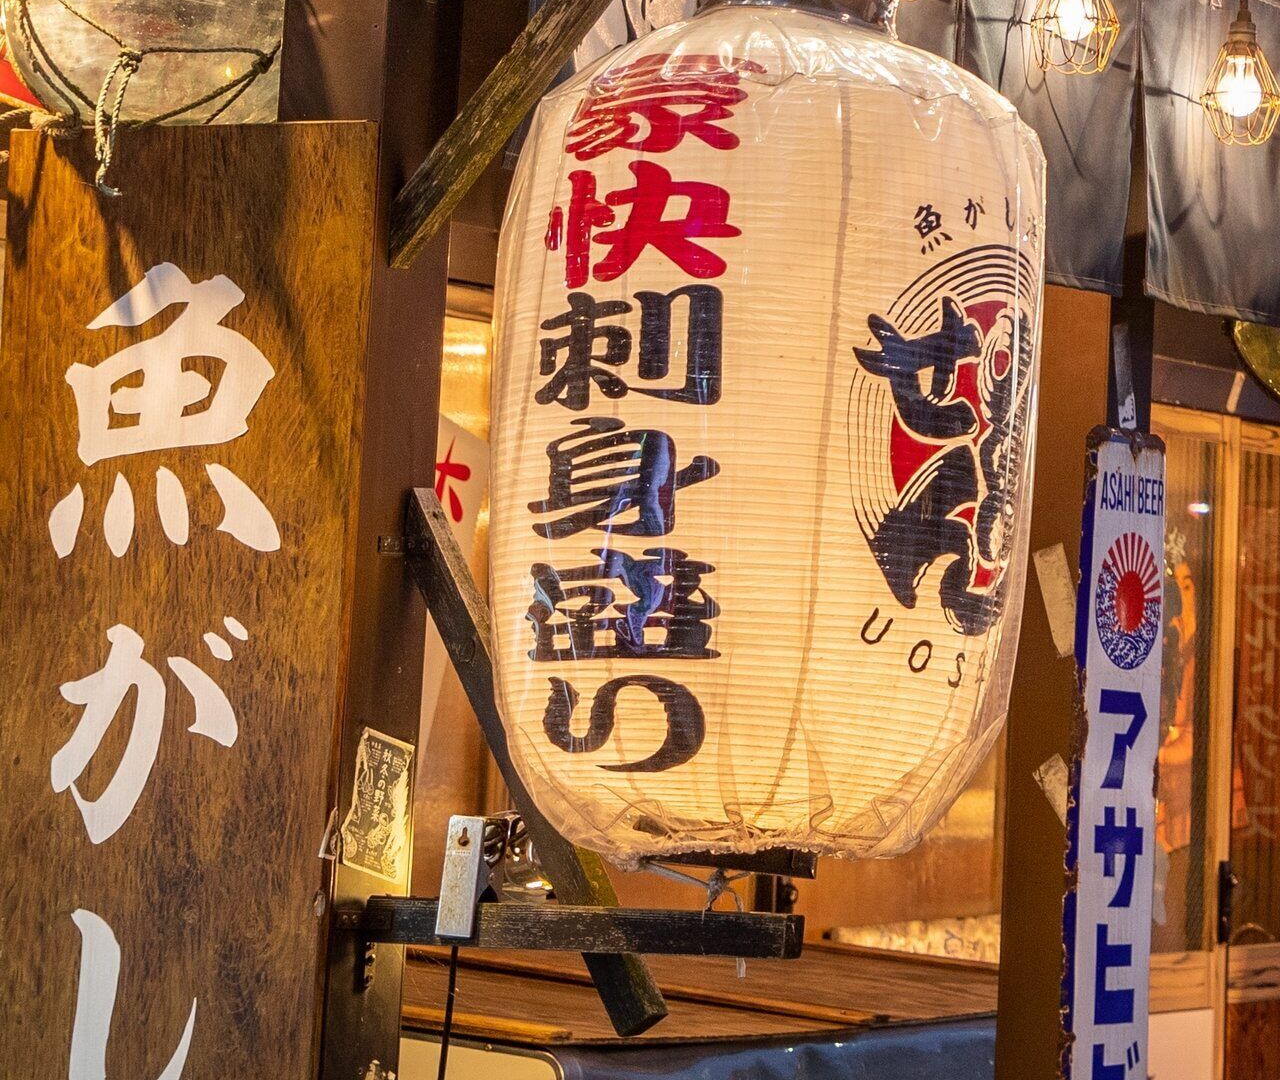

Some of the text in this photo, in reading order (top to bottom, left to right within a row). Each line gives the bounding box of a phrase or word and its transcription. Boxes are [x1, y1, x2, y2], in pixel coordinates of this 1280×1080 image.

[527, 52, 764, 773] 豪快刺身盛り
[1100, 469, 1164, 518] ASAHI BEER
